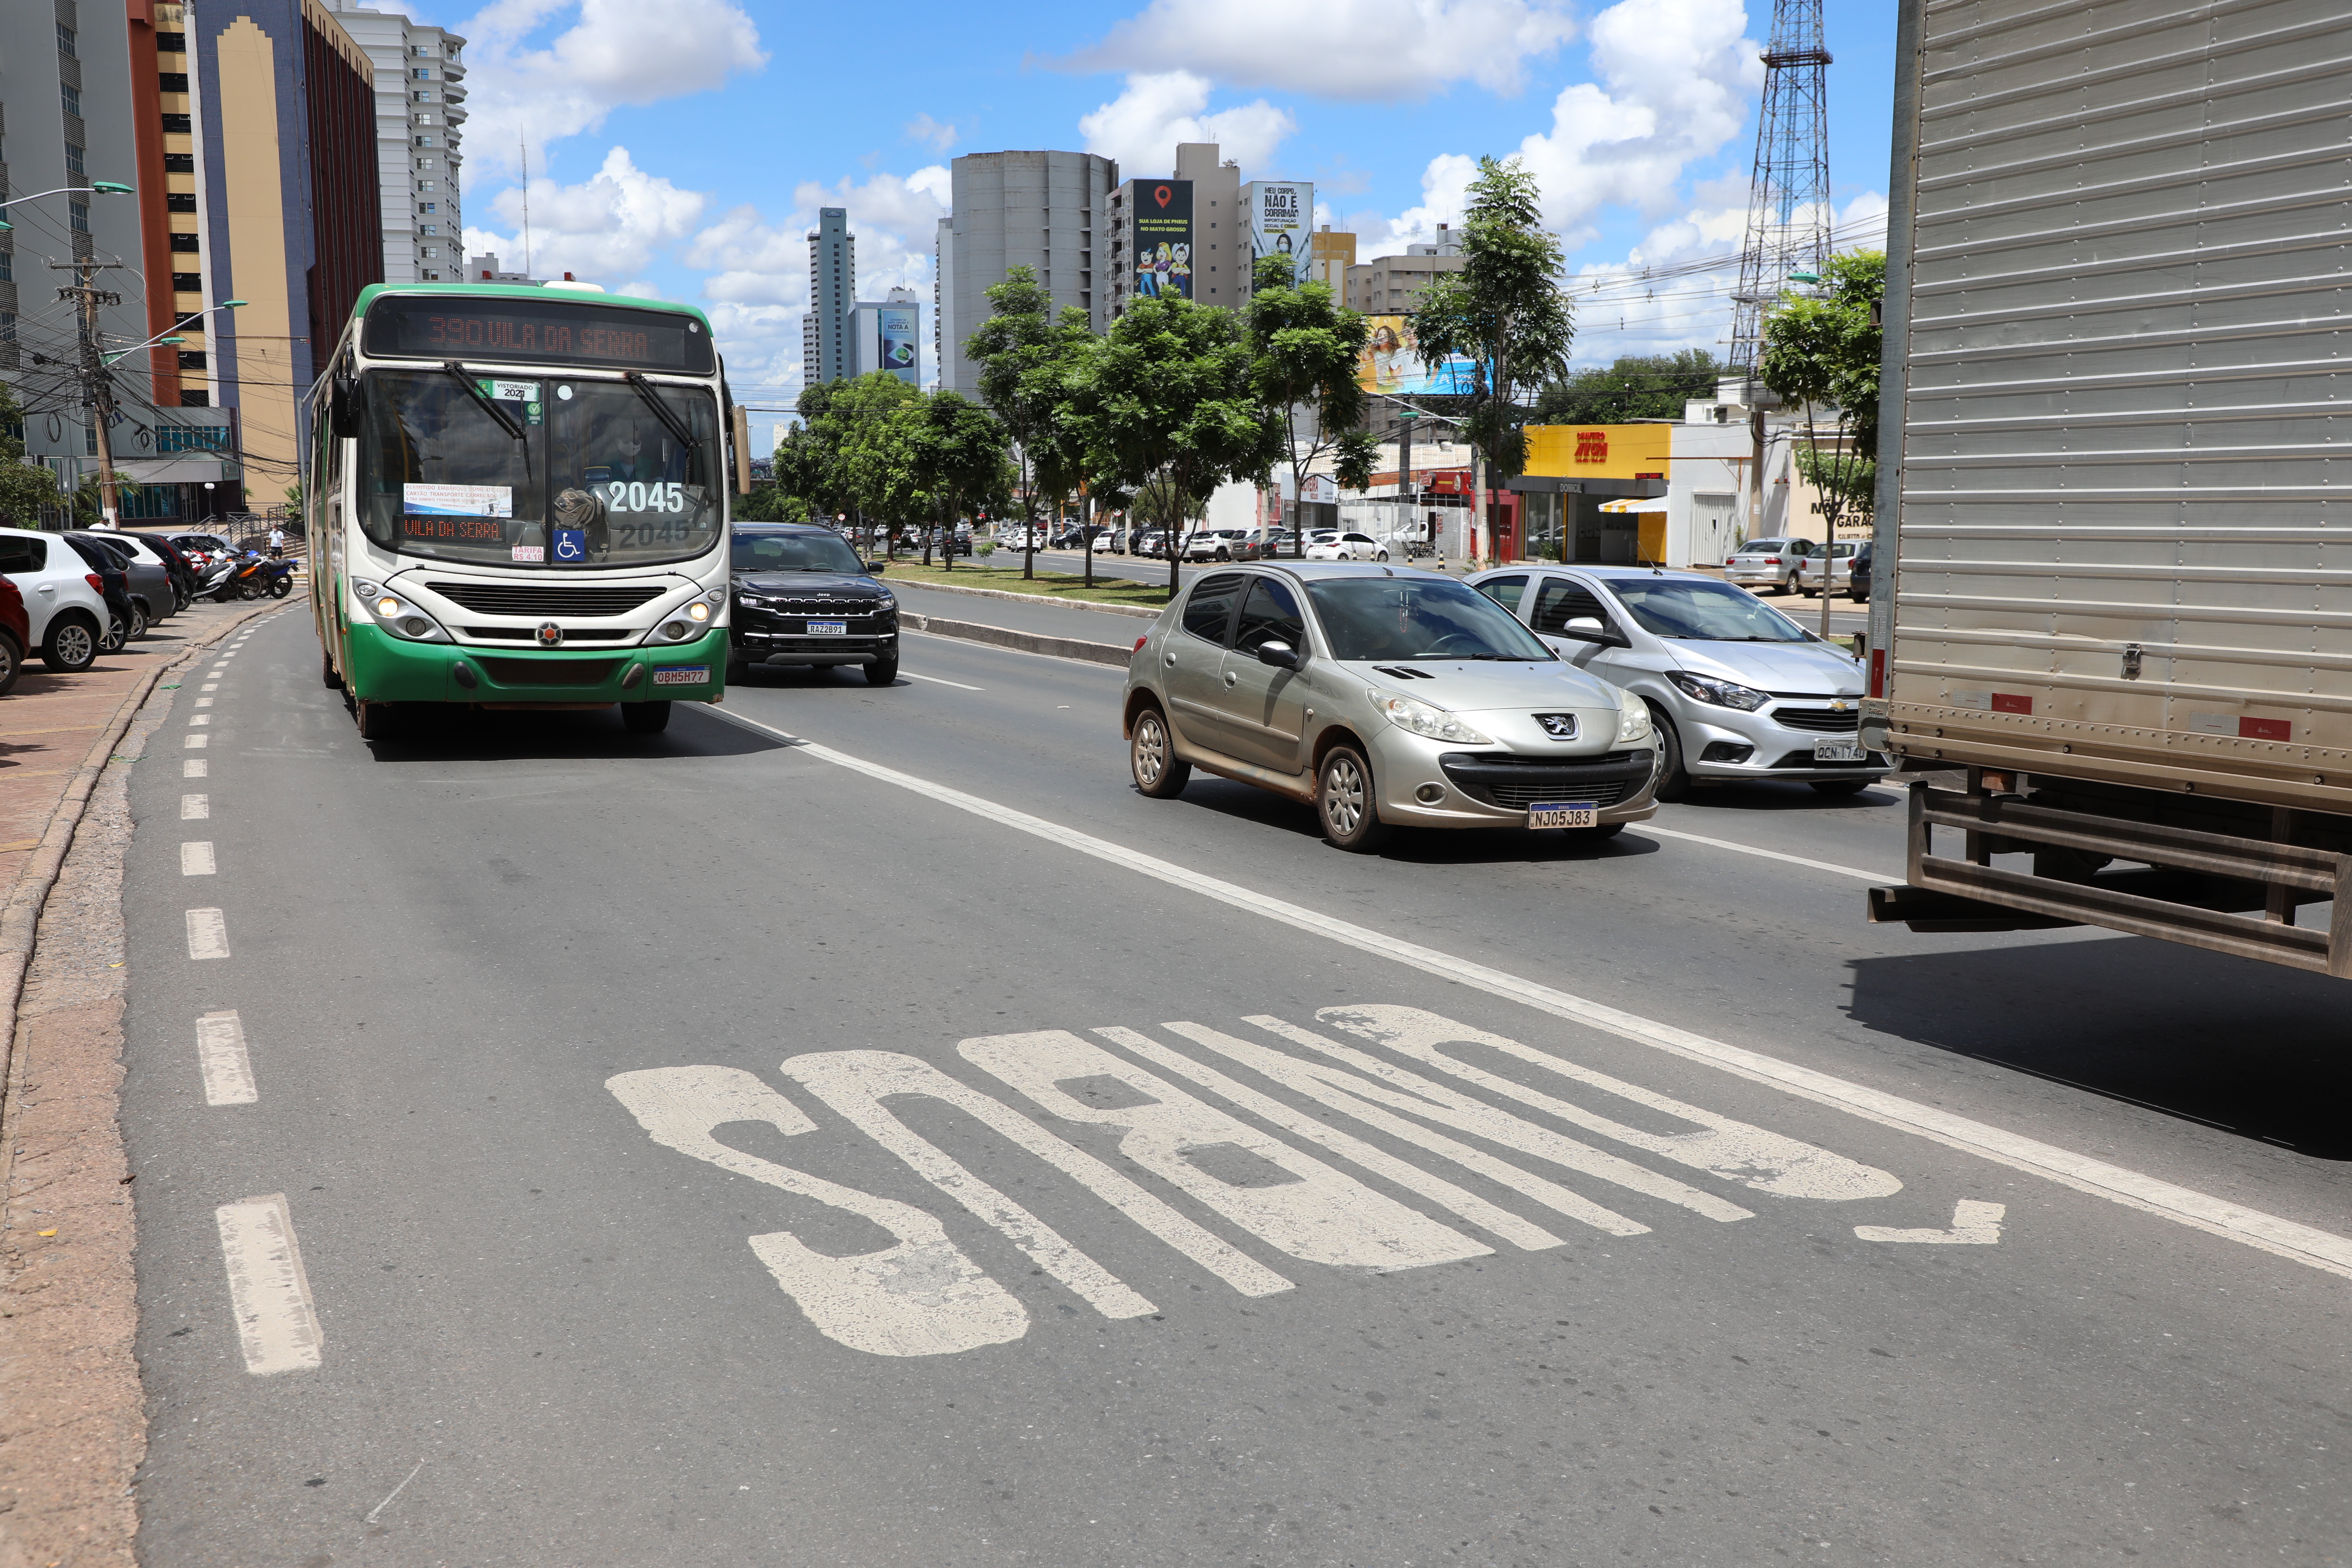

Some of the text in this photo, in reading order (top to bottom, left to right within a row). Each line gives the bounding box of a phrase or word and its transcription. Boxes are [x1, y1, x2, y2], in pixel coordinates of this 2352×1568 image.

[1265, 192, 1297, 208] NÃO É
[545, 326, 571, 351] DA
[580, 329, 647, 357] SERRA
[1560, 483, 1582, 493] DOMICIL
[609, 481, 683, 513] 2045
[405, 520, 499, 538] VILA DA SERRA
[658, 672, 703, 682] OBM5H77
